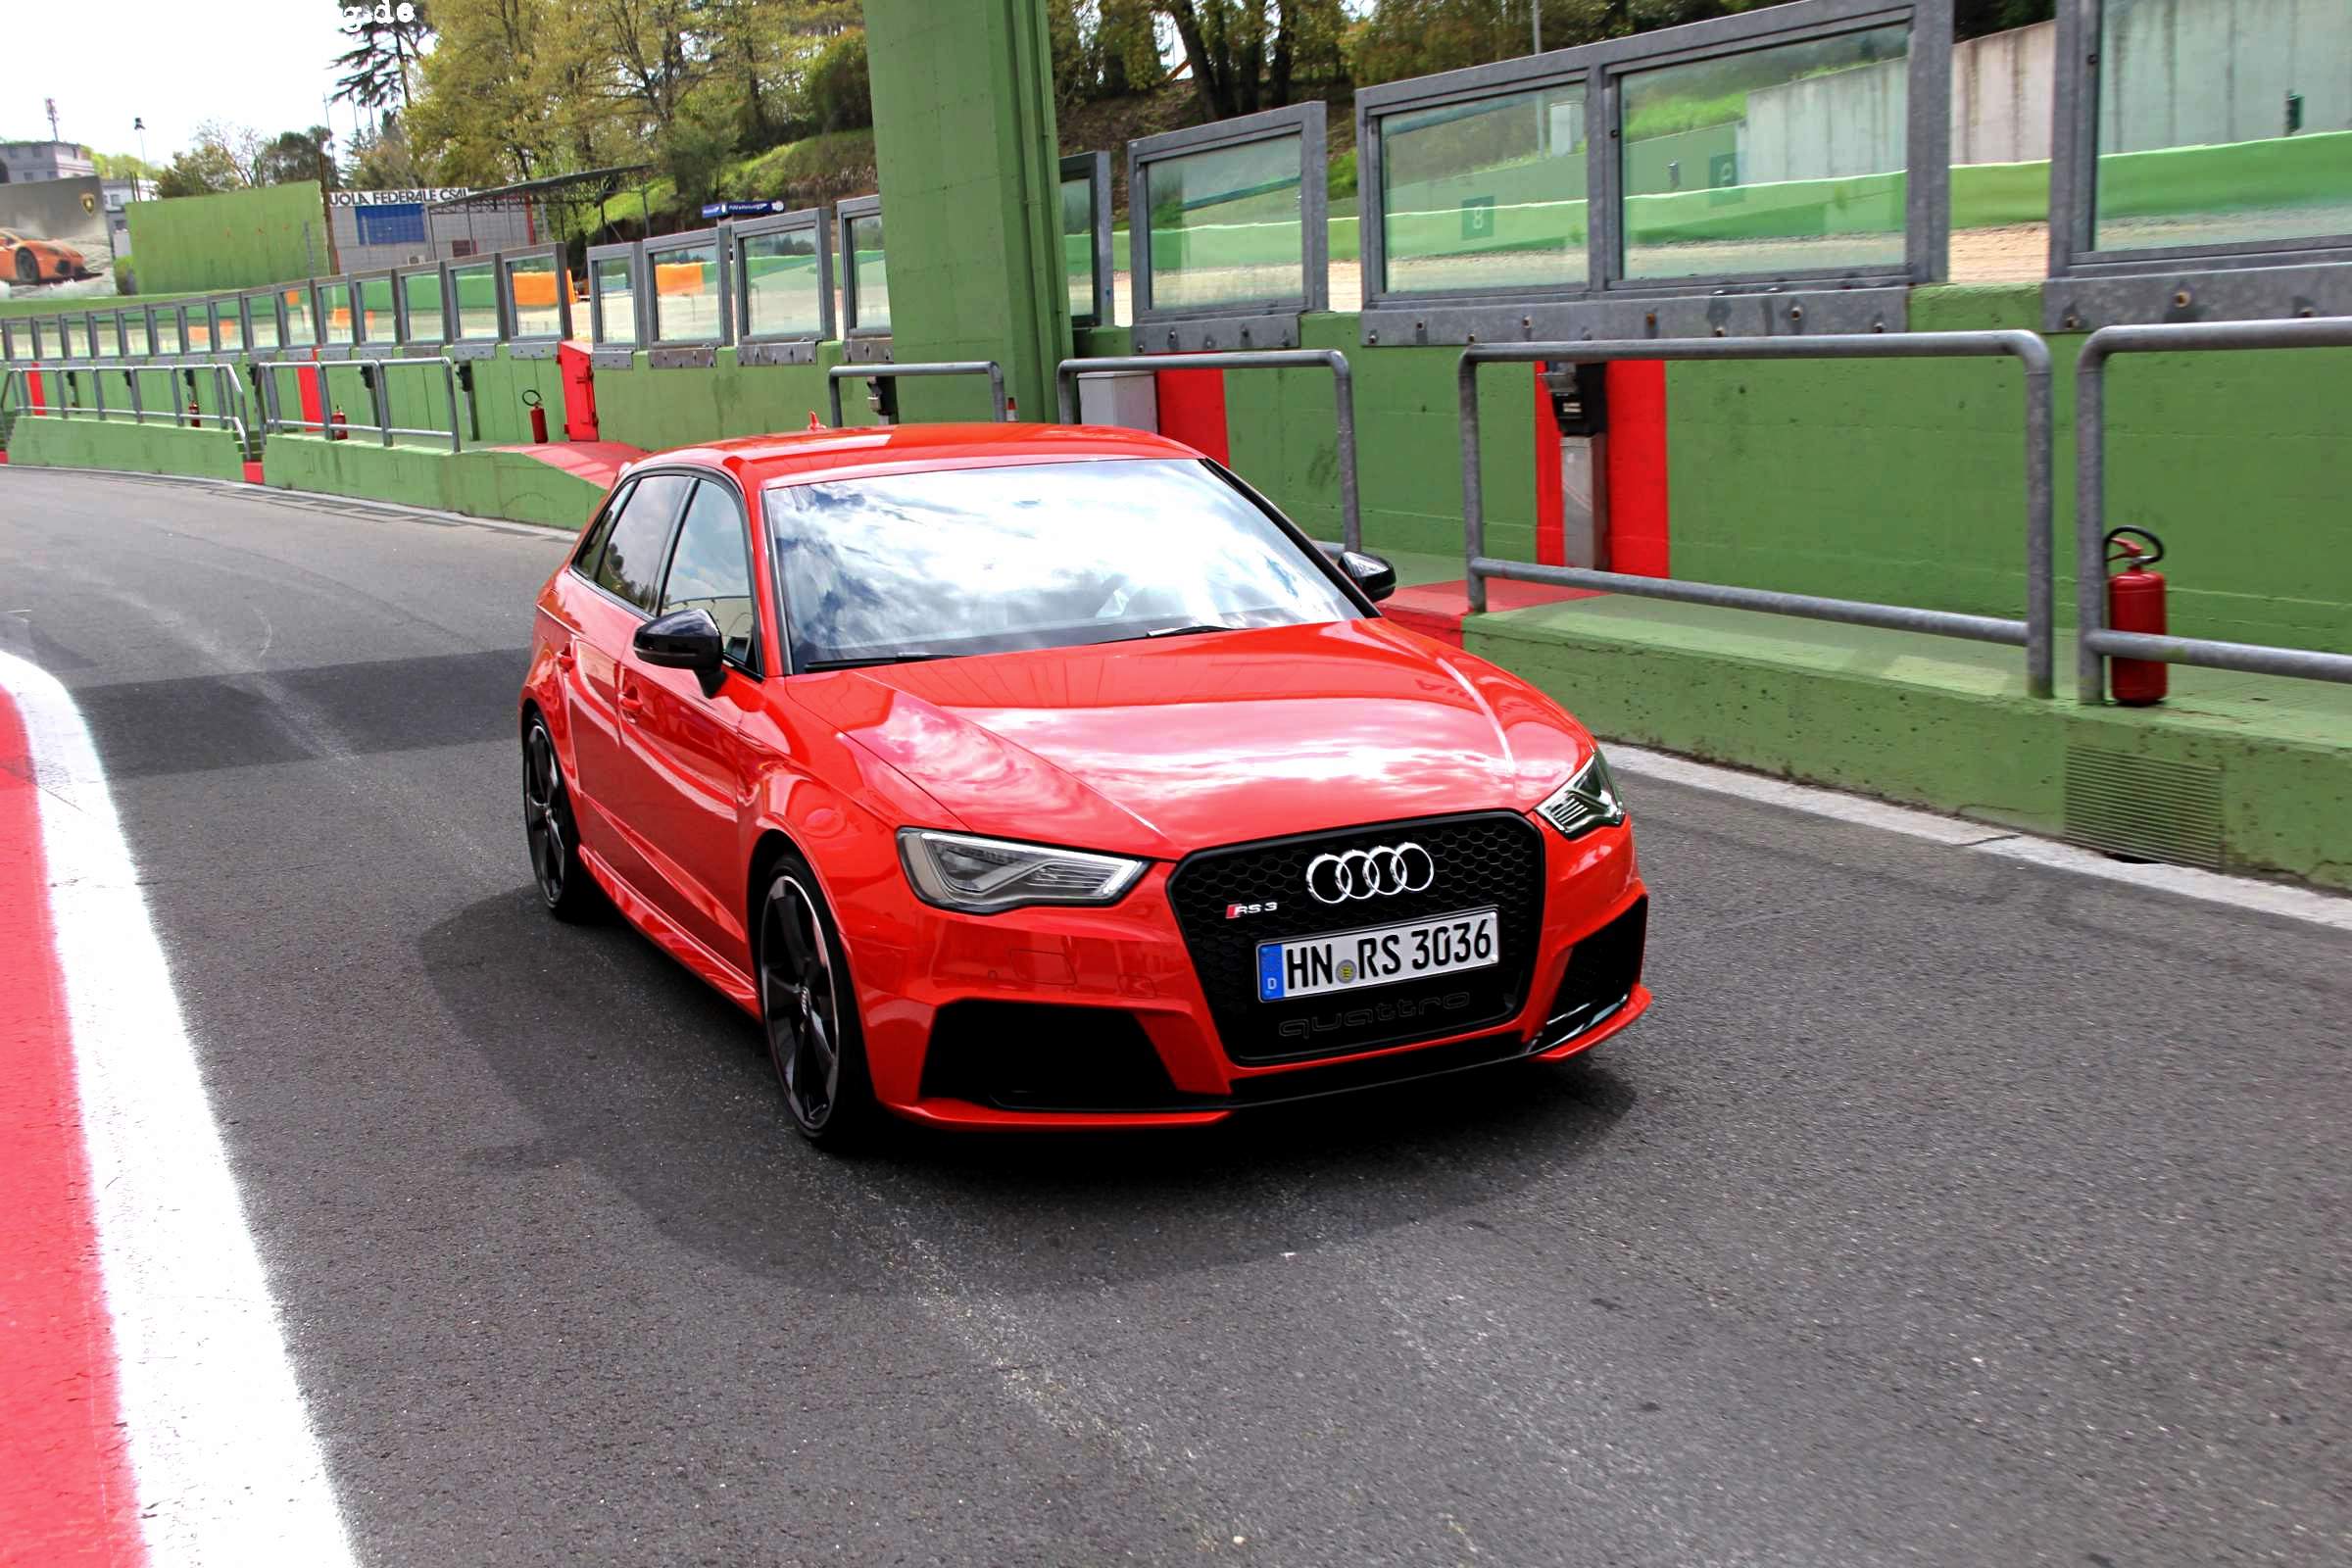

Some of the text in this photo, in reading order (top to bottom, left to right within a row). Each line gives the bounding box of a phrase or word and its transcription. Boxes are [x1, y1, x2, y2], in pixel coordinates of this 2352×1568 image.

[329, 192, 369, 207] UOLA
[372, 189, 437, 205] FEDERALE
[1234, 901, 1278, 916] RS 3
[1266, 919, 1492, 991] D HN RS 3036
[1278, 991, 1471, 1039] quattro
